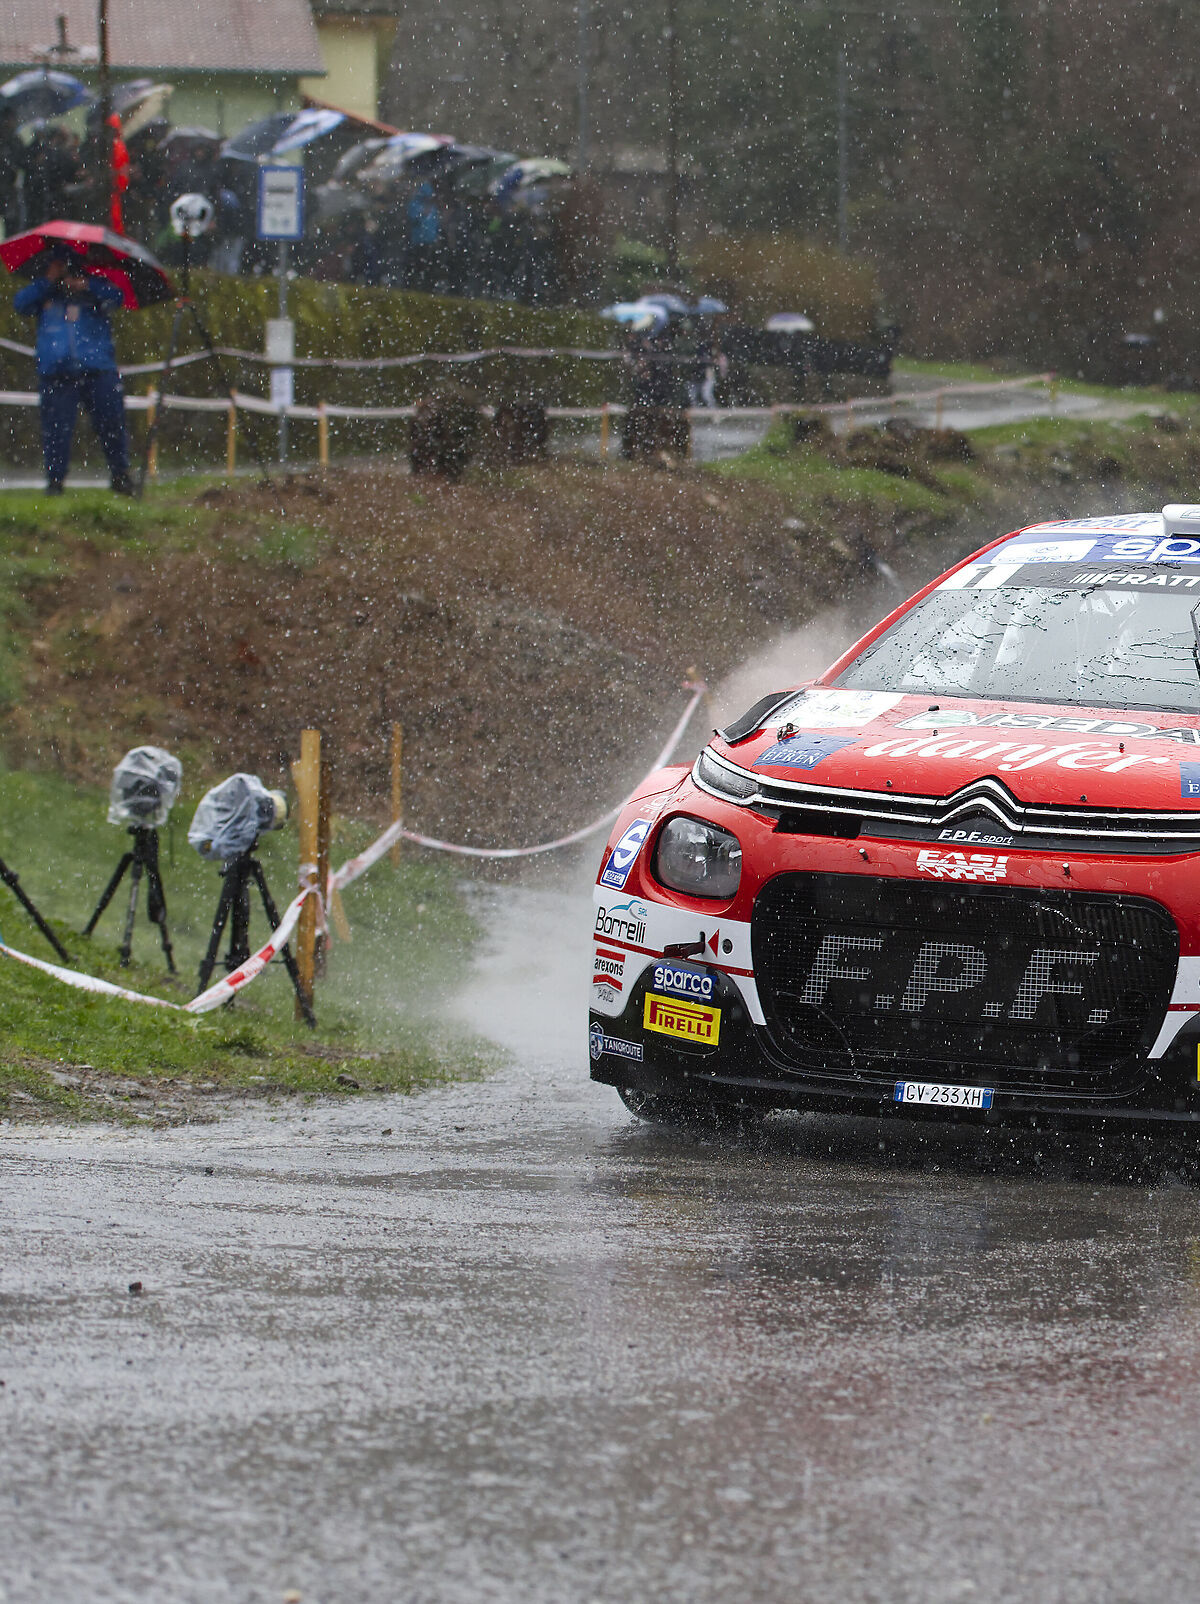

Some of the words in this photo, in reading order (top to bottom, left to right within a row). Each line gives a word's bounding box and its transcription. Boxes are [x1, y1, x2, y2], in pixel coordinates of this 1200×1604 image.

[761, 751, 821, 764] EFREN
[595, 906, 646, 944] Borrelli
[594, 956, 624, 977] arexons
[653, 966, 713, 995] sparco
[649, 1000, 714, 1038] PIRELLI
